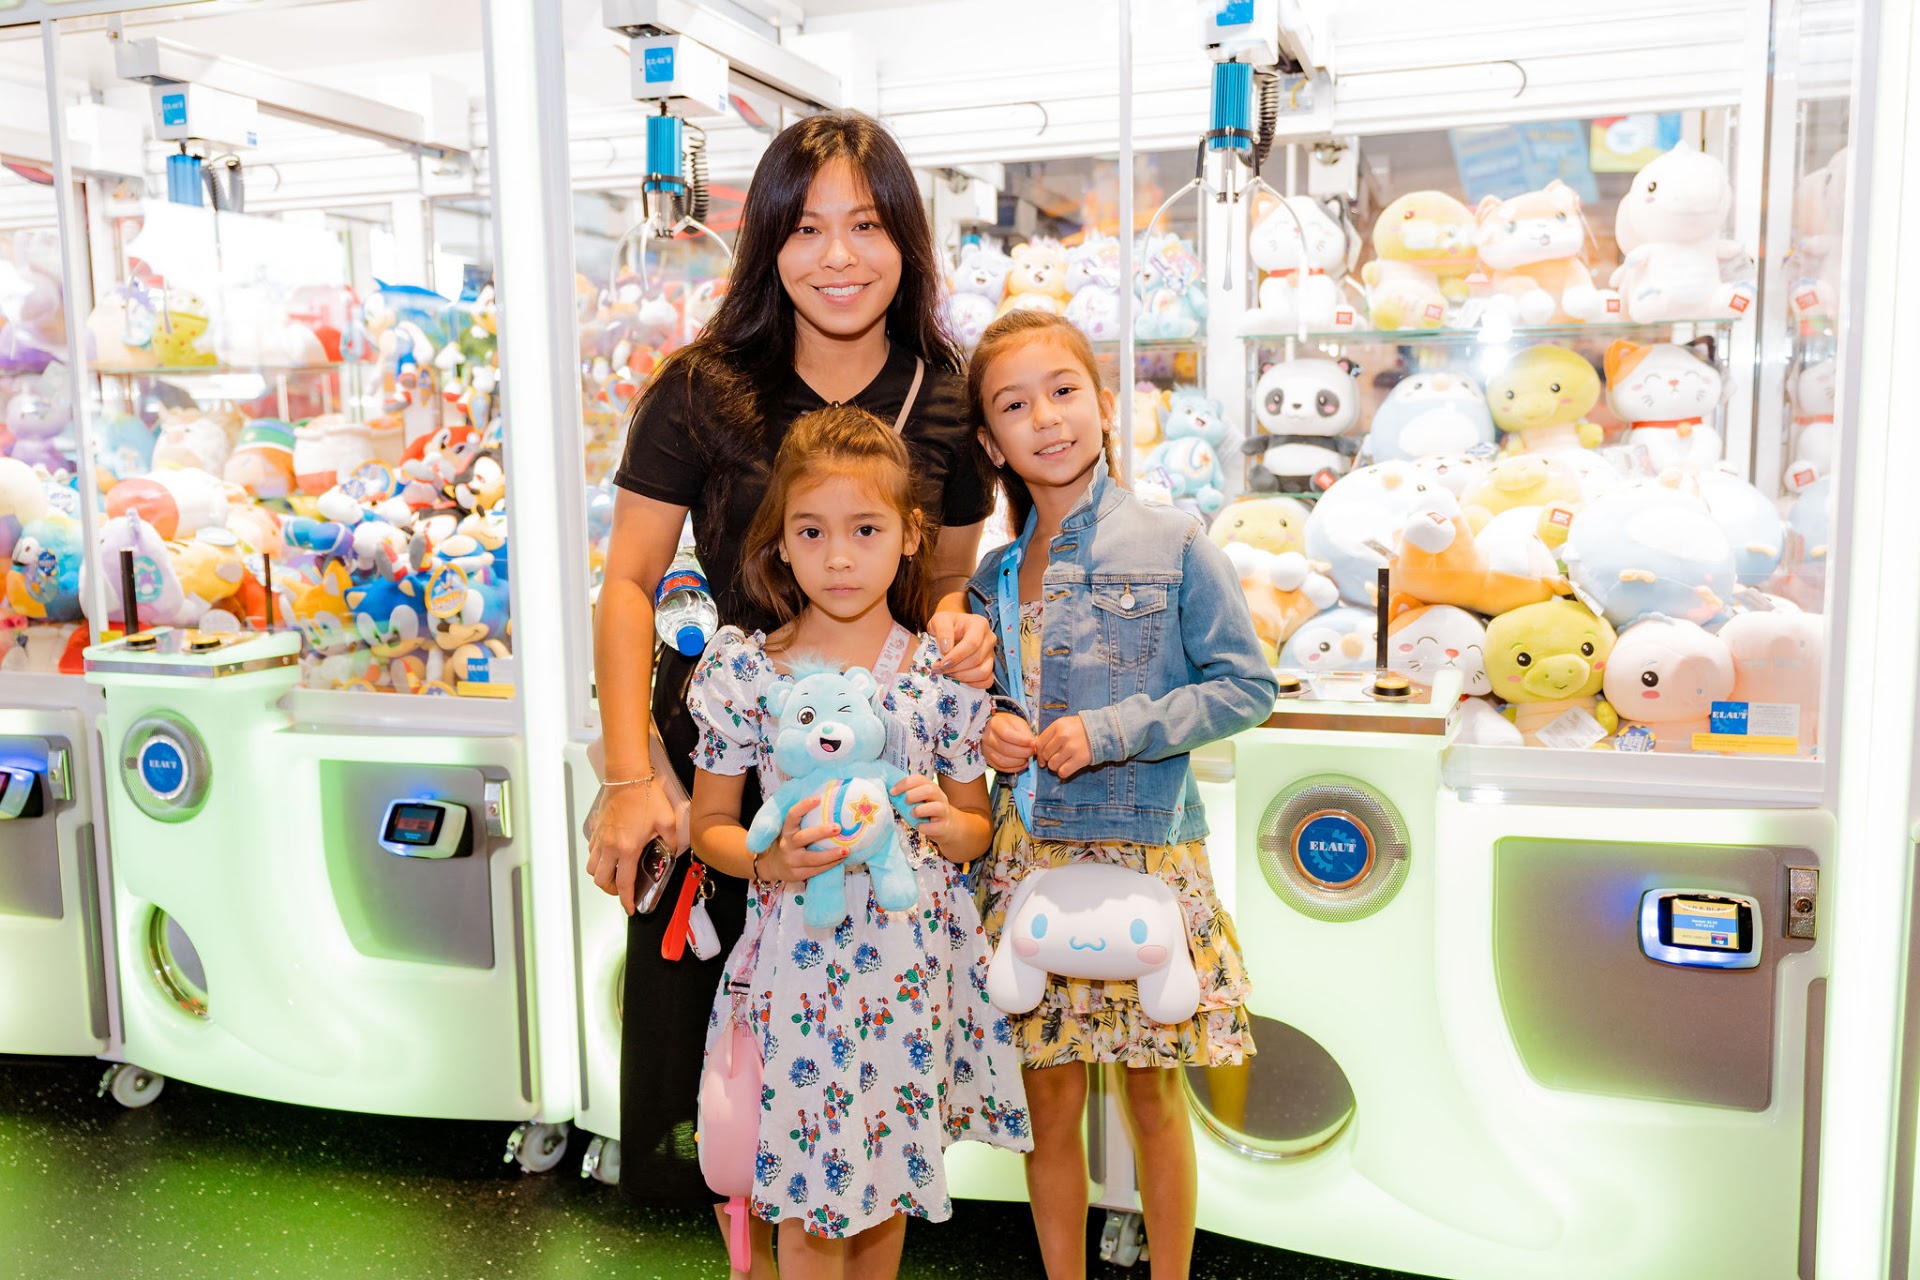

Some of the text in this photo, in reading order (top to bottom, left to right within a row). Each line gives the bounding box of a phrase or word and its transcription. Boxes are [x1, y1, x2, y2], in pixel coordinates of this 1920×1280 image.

[1712, 710, 1748, 719] ELAUT
[148, 759, 177, 769] ELAUT
[1309, 840, 1357, 853] ELAUT
